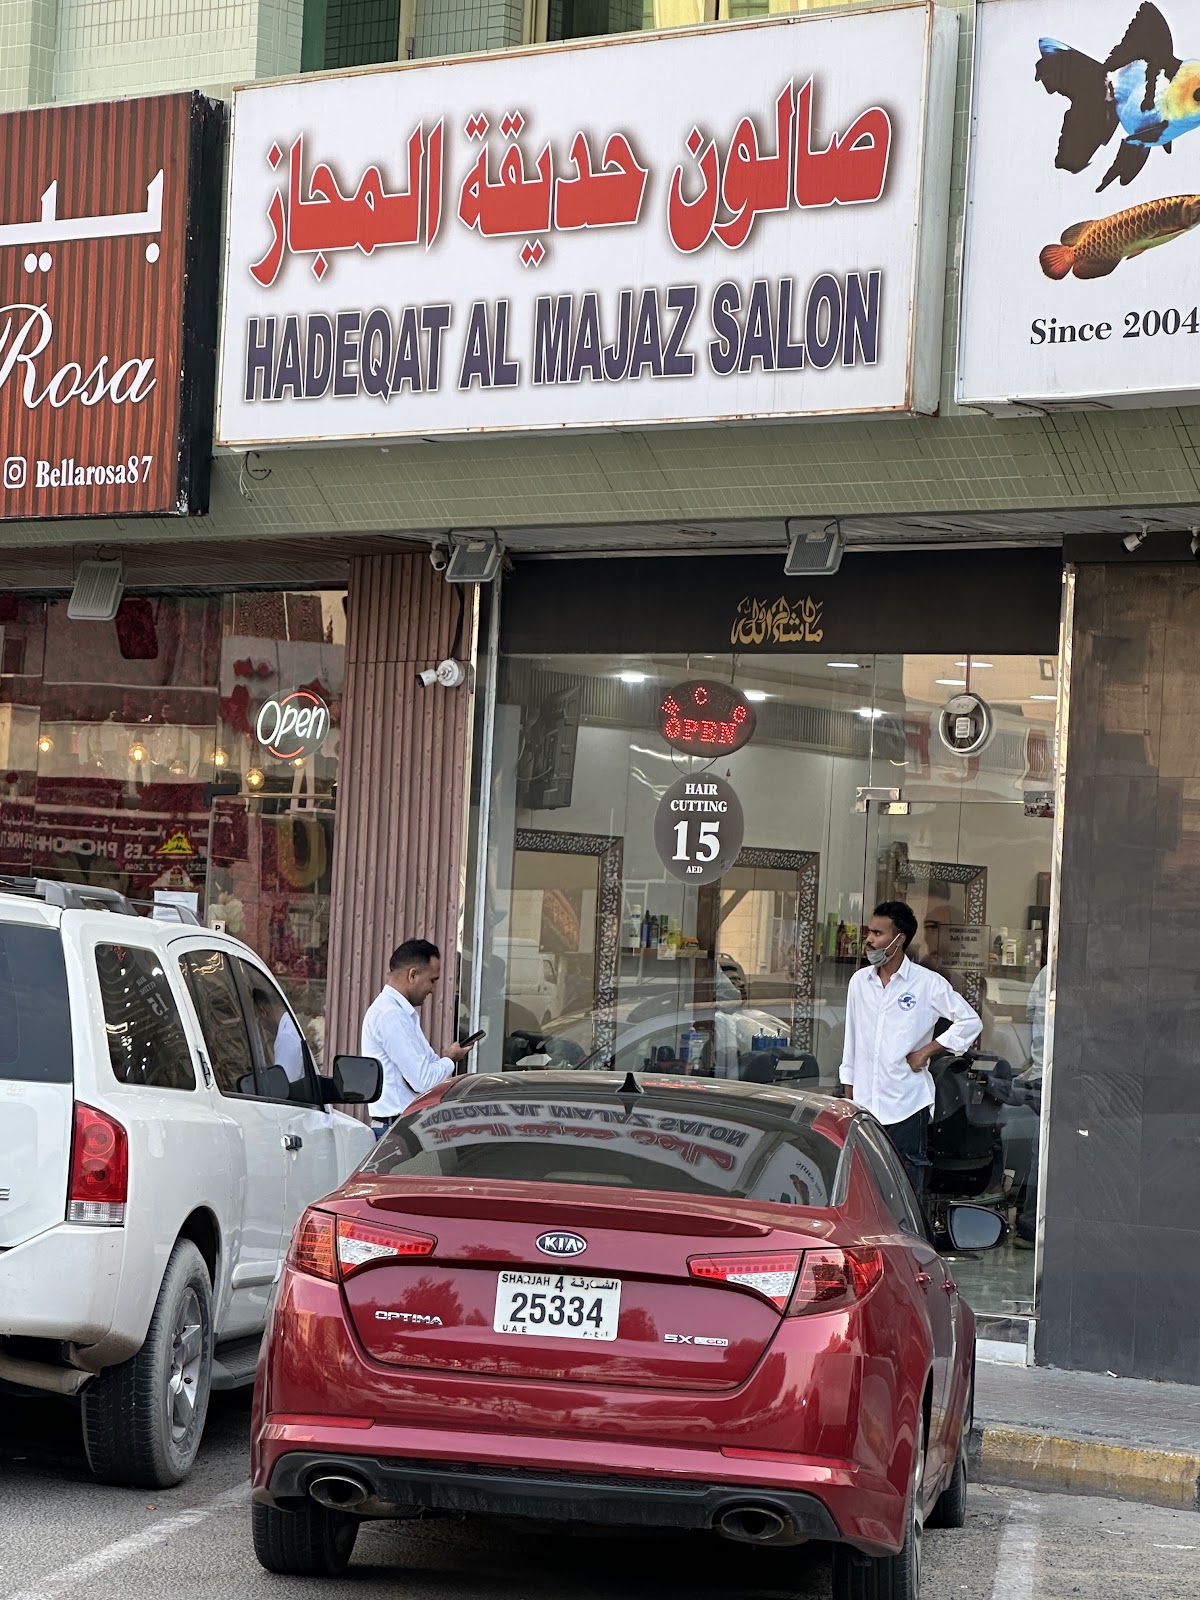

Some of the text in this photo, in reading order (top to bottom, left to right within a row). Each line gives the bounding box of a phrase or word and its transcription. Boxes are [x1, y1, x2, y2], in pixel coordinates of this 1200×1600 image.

[249, 74, 892, 287] صالون حديقة المجاز
[244, 270, 881, 403] HADEQAT AL MAJAZ SALON
[1030, 306, 1200, 345] Since 2004
[0, 302, 156, 408] Rosa
[35, 456, 153, 488] Bellarosa87
[256, 700, 326, 748] Open
[665, 717, 737, 744] OPEN
[685, 783, 718, 795] HAIR
[670, 799, 728, 812] CUTTING
[672, 820, 720, 862] 15
[686, 865, 703, 874] AED
[544, 1236, 581, 1252] KIA
[554, 1276, 564, 1292] 4
[375, 1311, 443, 1326] OPTIMA
[509, 1292, 603, 1328] 25334
[663, 1333, 693, 1345] SX
